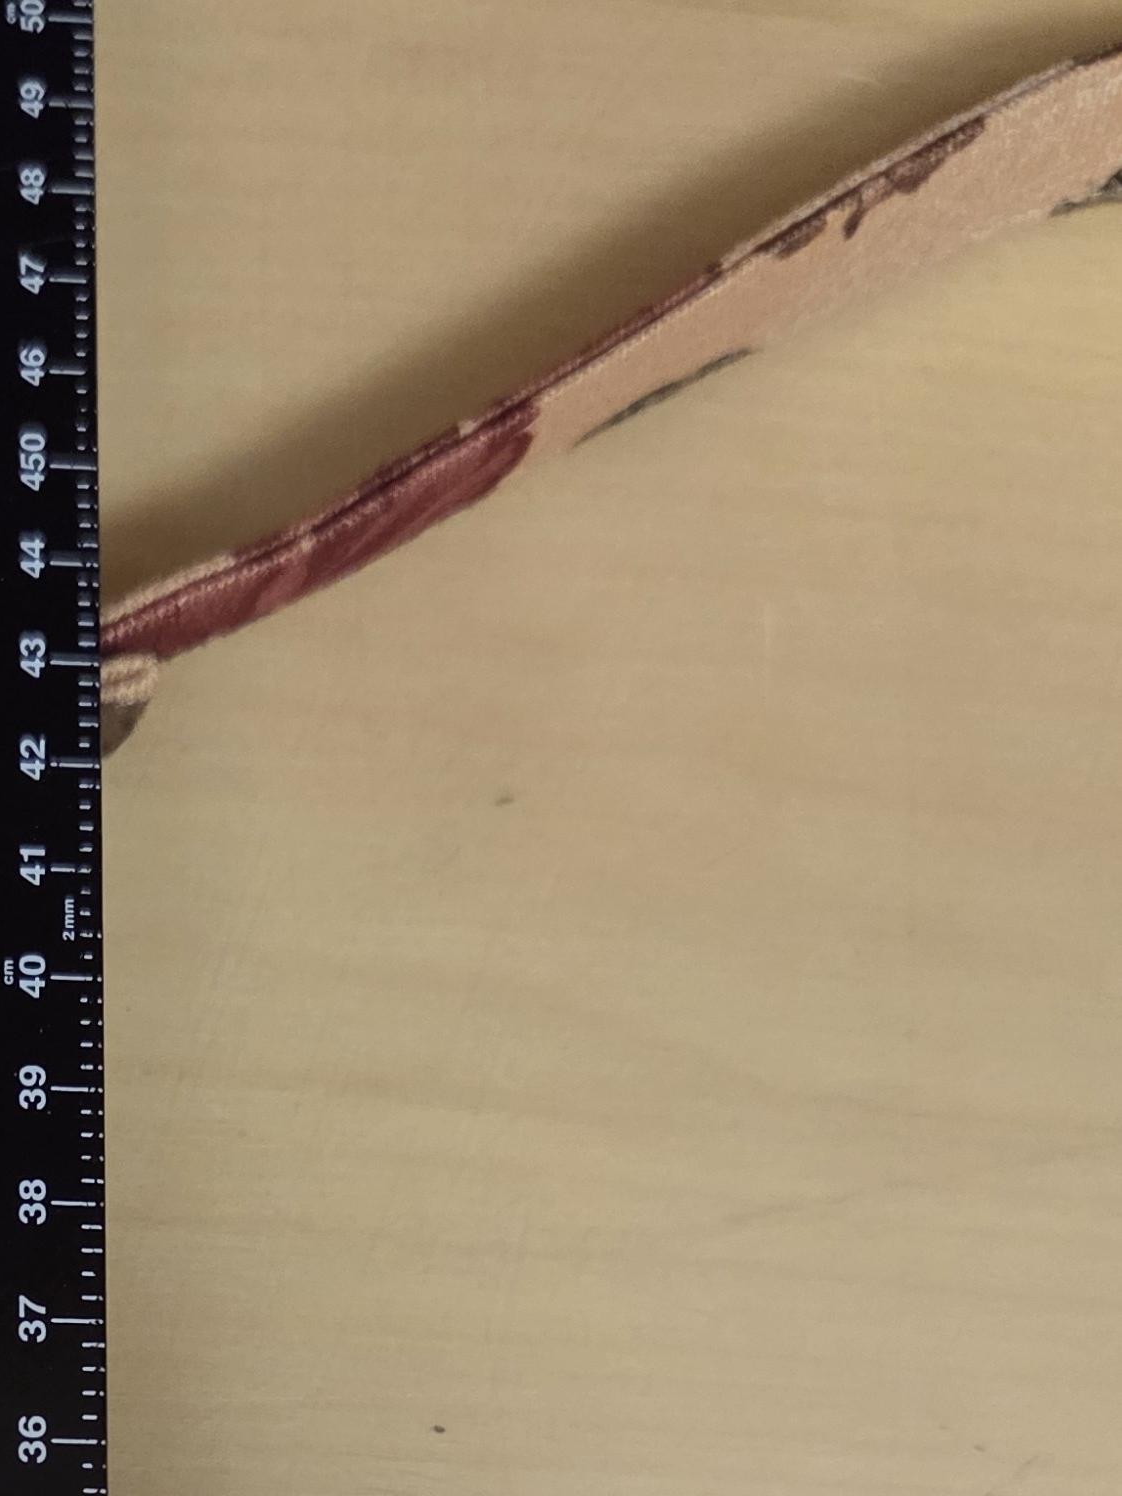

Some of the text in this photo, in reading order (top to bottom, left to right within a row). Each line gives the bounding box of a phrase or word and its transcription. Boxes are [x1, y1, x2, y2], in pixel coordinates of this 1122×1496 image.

[7, 3, 16, 23] cm
[20, 0, 44, 32] 50
[20, 81, 44, 118] 49
[20, 168, 45, 204] 48
[20, 256, 44, 294] 47
[20, 348, 45, 386] 46
[20, 433, 45, 491] 450
[20, 538, 45, 578] 44
[20, 638, 45, 677] 43
[20, 739, 45, 780] 42
[20, 848, 45, 885] 41
[4, 960, 13, 984] cm
[19, 955, 45, 998] 40
[19, 1066, 46, 1109] 39
[19, 1180, 46, 1224] 38
[19, 1295, 46, 1342] 37
[18, 1416, 46, 1463] 36
